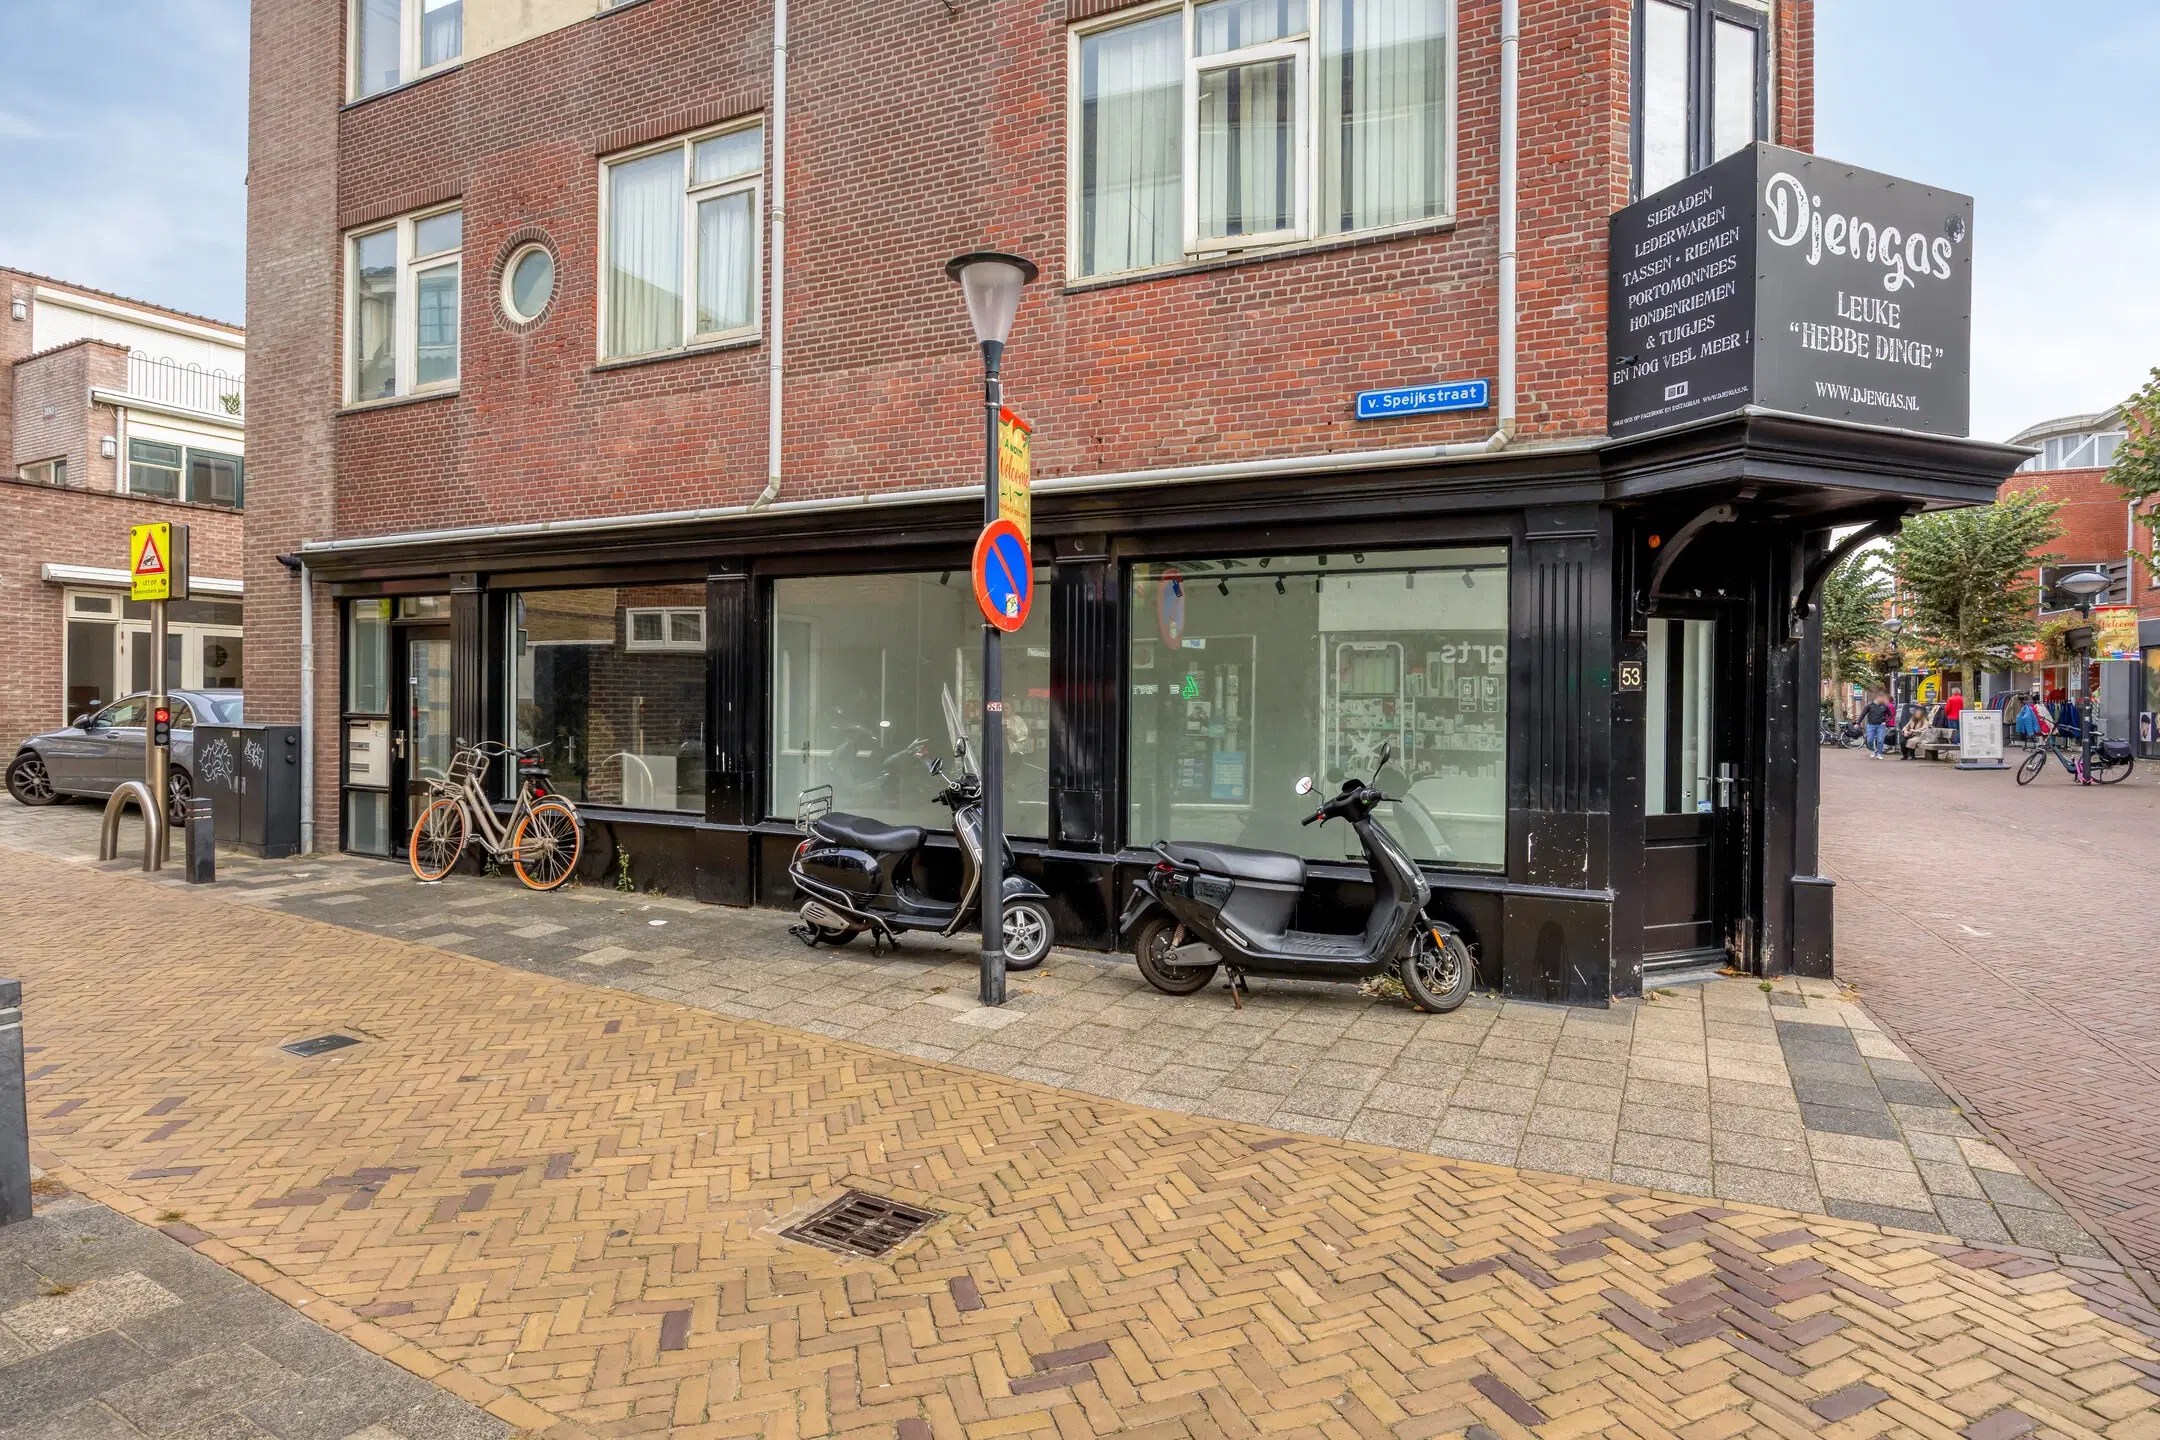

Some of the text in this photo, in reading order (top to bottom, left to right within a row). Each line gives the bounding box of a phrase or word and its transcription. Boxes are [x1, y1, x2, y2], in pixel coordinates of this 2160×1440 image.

[1647, 186, 1713, 228] SIERADEN
[1634, 206, 1726, 258] LEDERWAREN
[1765, 172, 1952, 292] Djengas
[1622, 227, 1740, 287] TASSEN RIEMEN
[1628, 255, 1737, 309] PORTOMONNEES
[1629, 280, 1736, 332] HONDENRIEMEN
[1838, 291, 1901, 329] LEUKE
[1645, 314, 1715, 350] & TUIGJES
[1613, 367, 1629, 385] EN
[1632, 359, 1659, 379] NOG
[1663, 347, 1697, 369] VEEL
[1700, 333, 1741, 358] MEER
[1368, 386, 1477, 408] v. Speijkstraat
[1640, 408, 1664, 420] FACEBOOK
[1672, 399, 1700, 411] INSTAGRAM
[1815, 381, 1920, 411] WWW.DJENGAS.NL
[1622, 667, 1640, 686] 53
